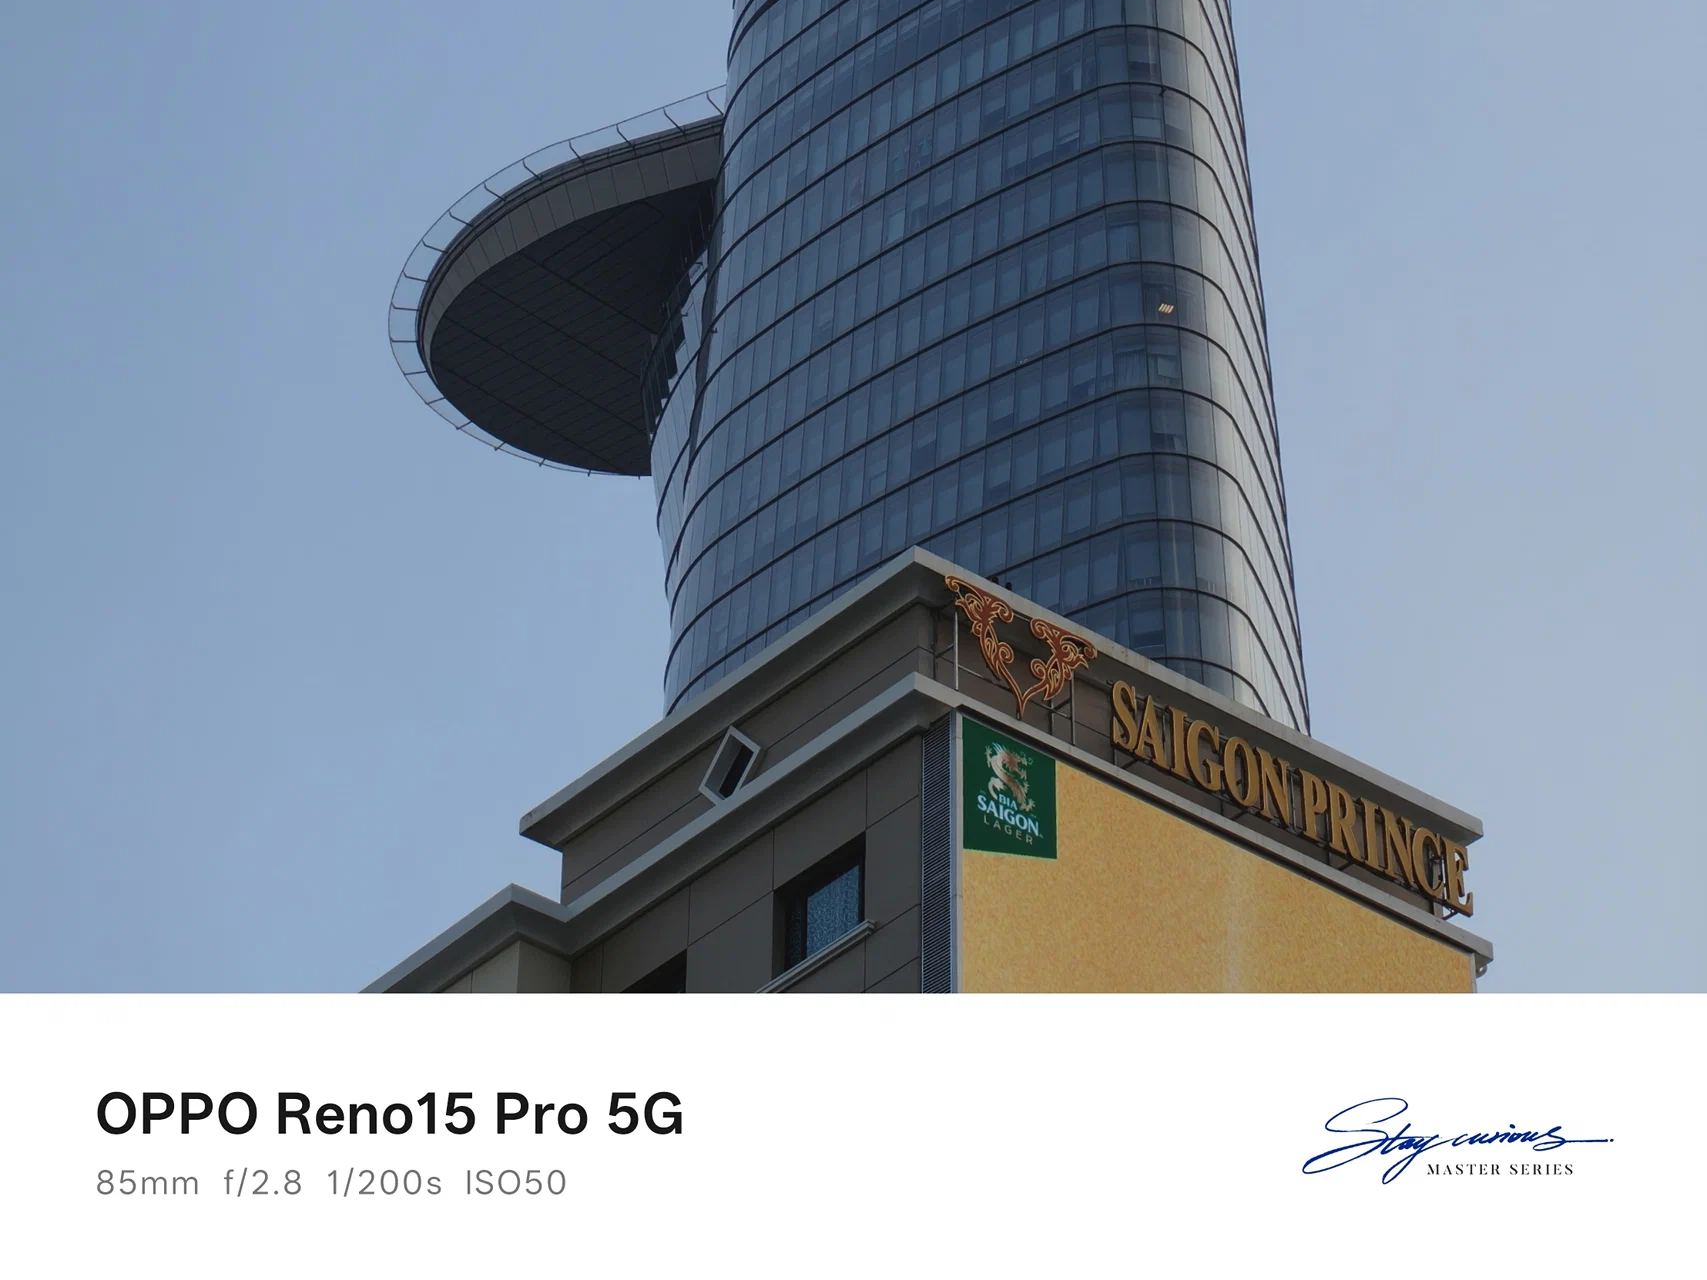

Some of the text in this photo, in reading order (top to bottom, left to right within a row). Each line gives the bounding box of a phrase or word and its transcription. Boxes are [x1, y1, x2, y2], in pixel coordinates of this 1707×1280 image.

[977, 794, 1039, 837] SAIGON
[998, 793, 1018, 811] BIA
[1112, 680, 1473, 917] SAIGON PRINCE
[983, 814, 1033, 846] LAGER
